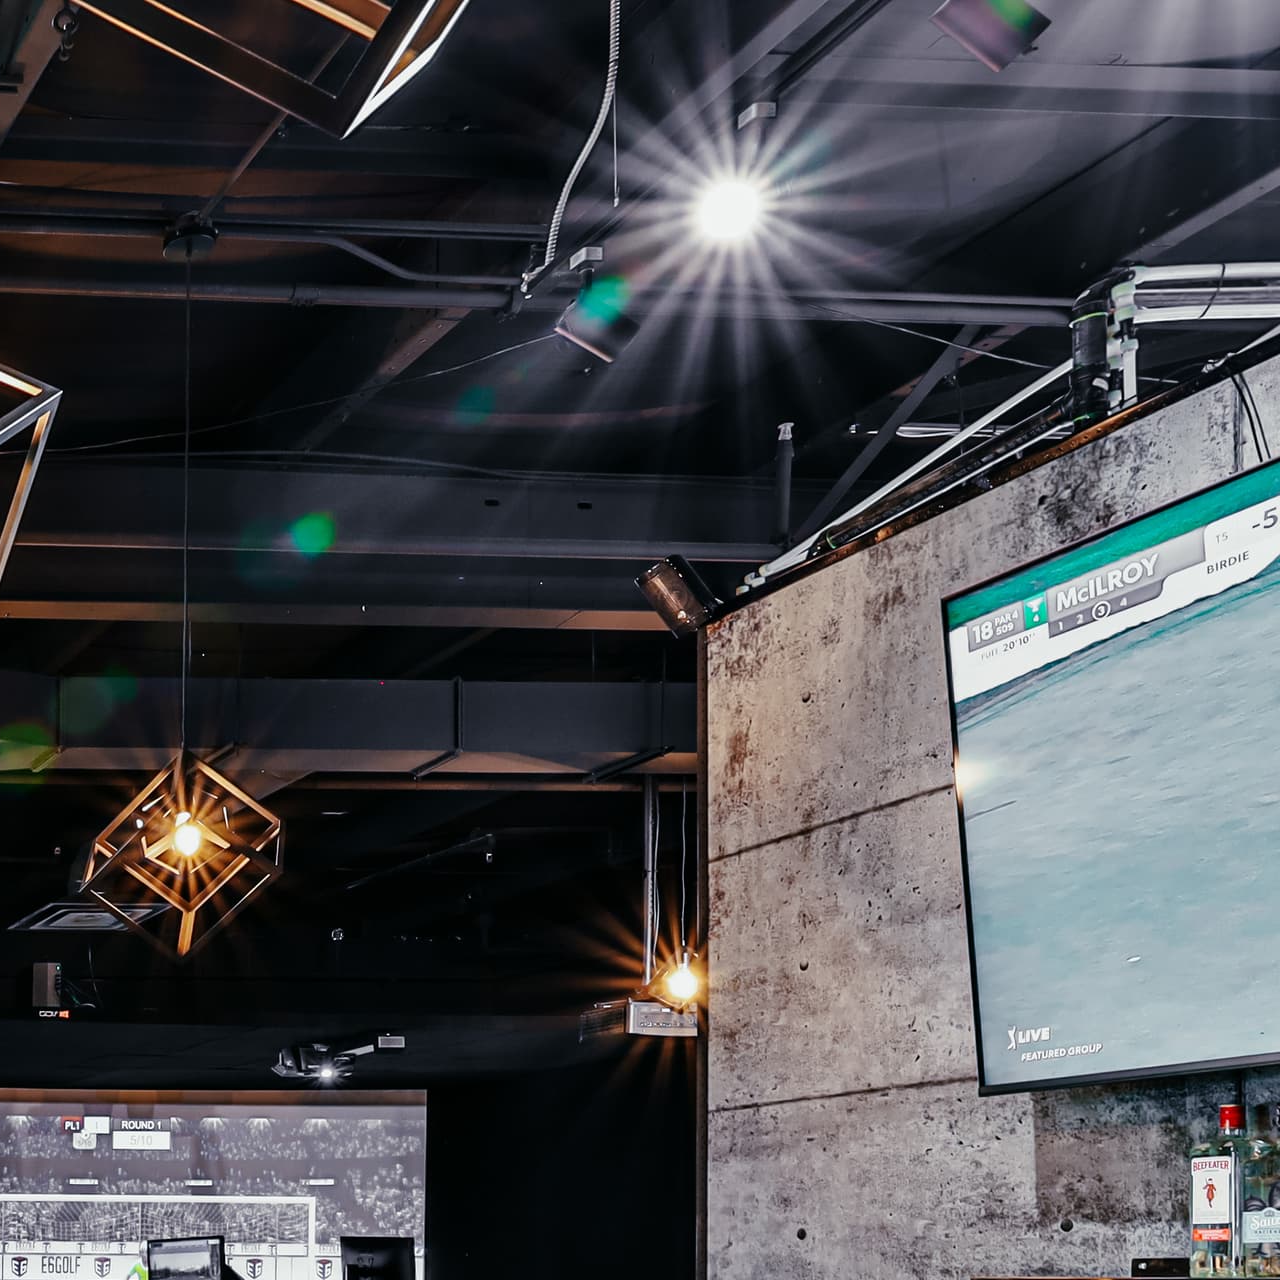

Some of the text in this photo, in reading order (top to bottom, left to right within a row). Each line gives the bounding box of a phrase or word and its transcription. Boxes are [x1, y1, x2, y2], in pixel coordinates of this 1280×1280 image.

[1252, 506, 1278, 529] -5
[1207, 550, 1249, 574] BIRDIE
[1056, 553, 1158, 612] McILROY
[995, 609, 1018, 626] PAR 4
[1076, 614, 1083, 625] 2
[1120, 597, 1127, 607] 4
[972, 621, 993, 643] 18
[996, 622, 1014, 635] 509
[1018, 1027, 1050, 1043] LIVE
[1021, 1043, 1103, 1062] FEATURED GROUP
[64, 1121, 80, 1130] PL1
[121, 1120, 155, 1130] ROUND
[129, 1135, 153, 1146] 5/10
[1193, 1160, 1229, 1172] BEEFEATER
[41, 1256, 81, 1274] E6GOLF
